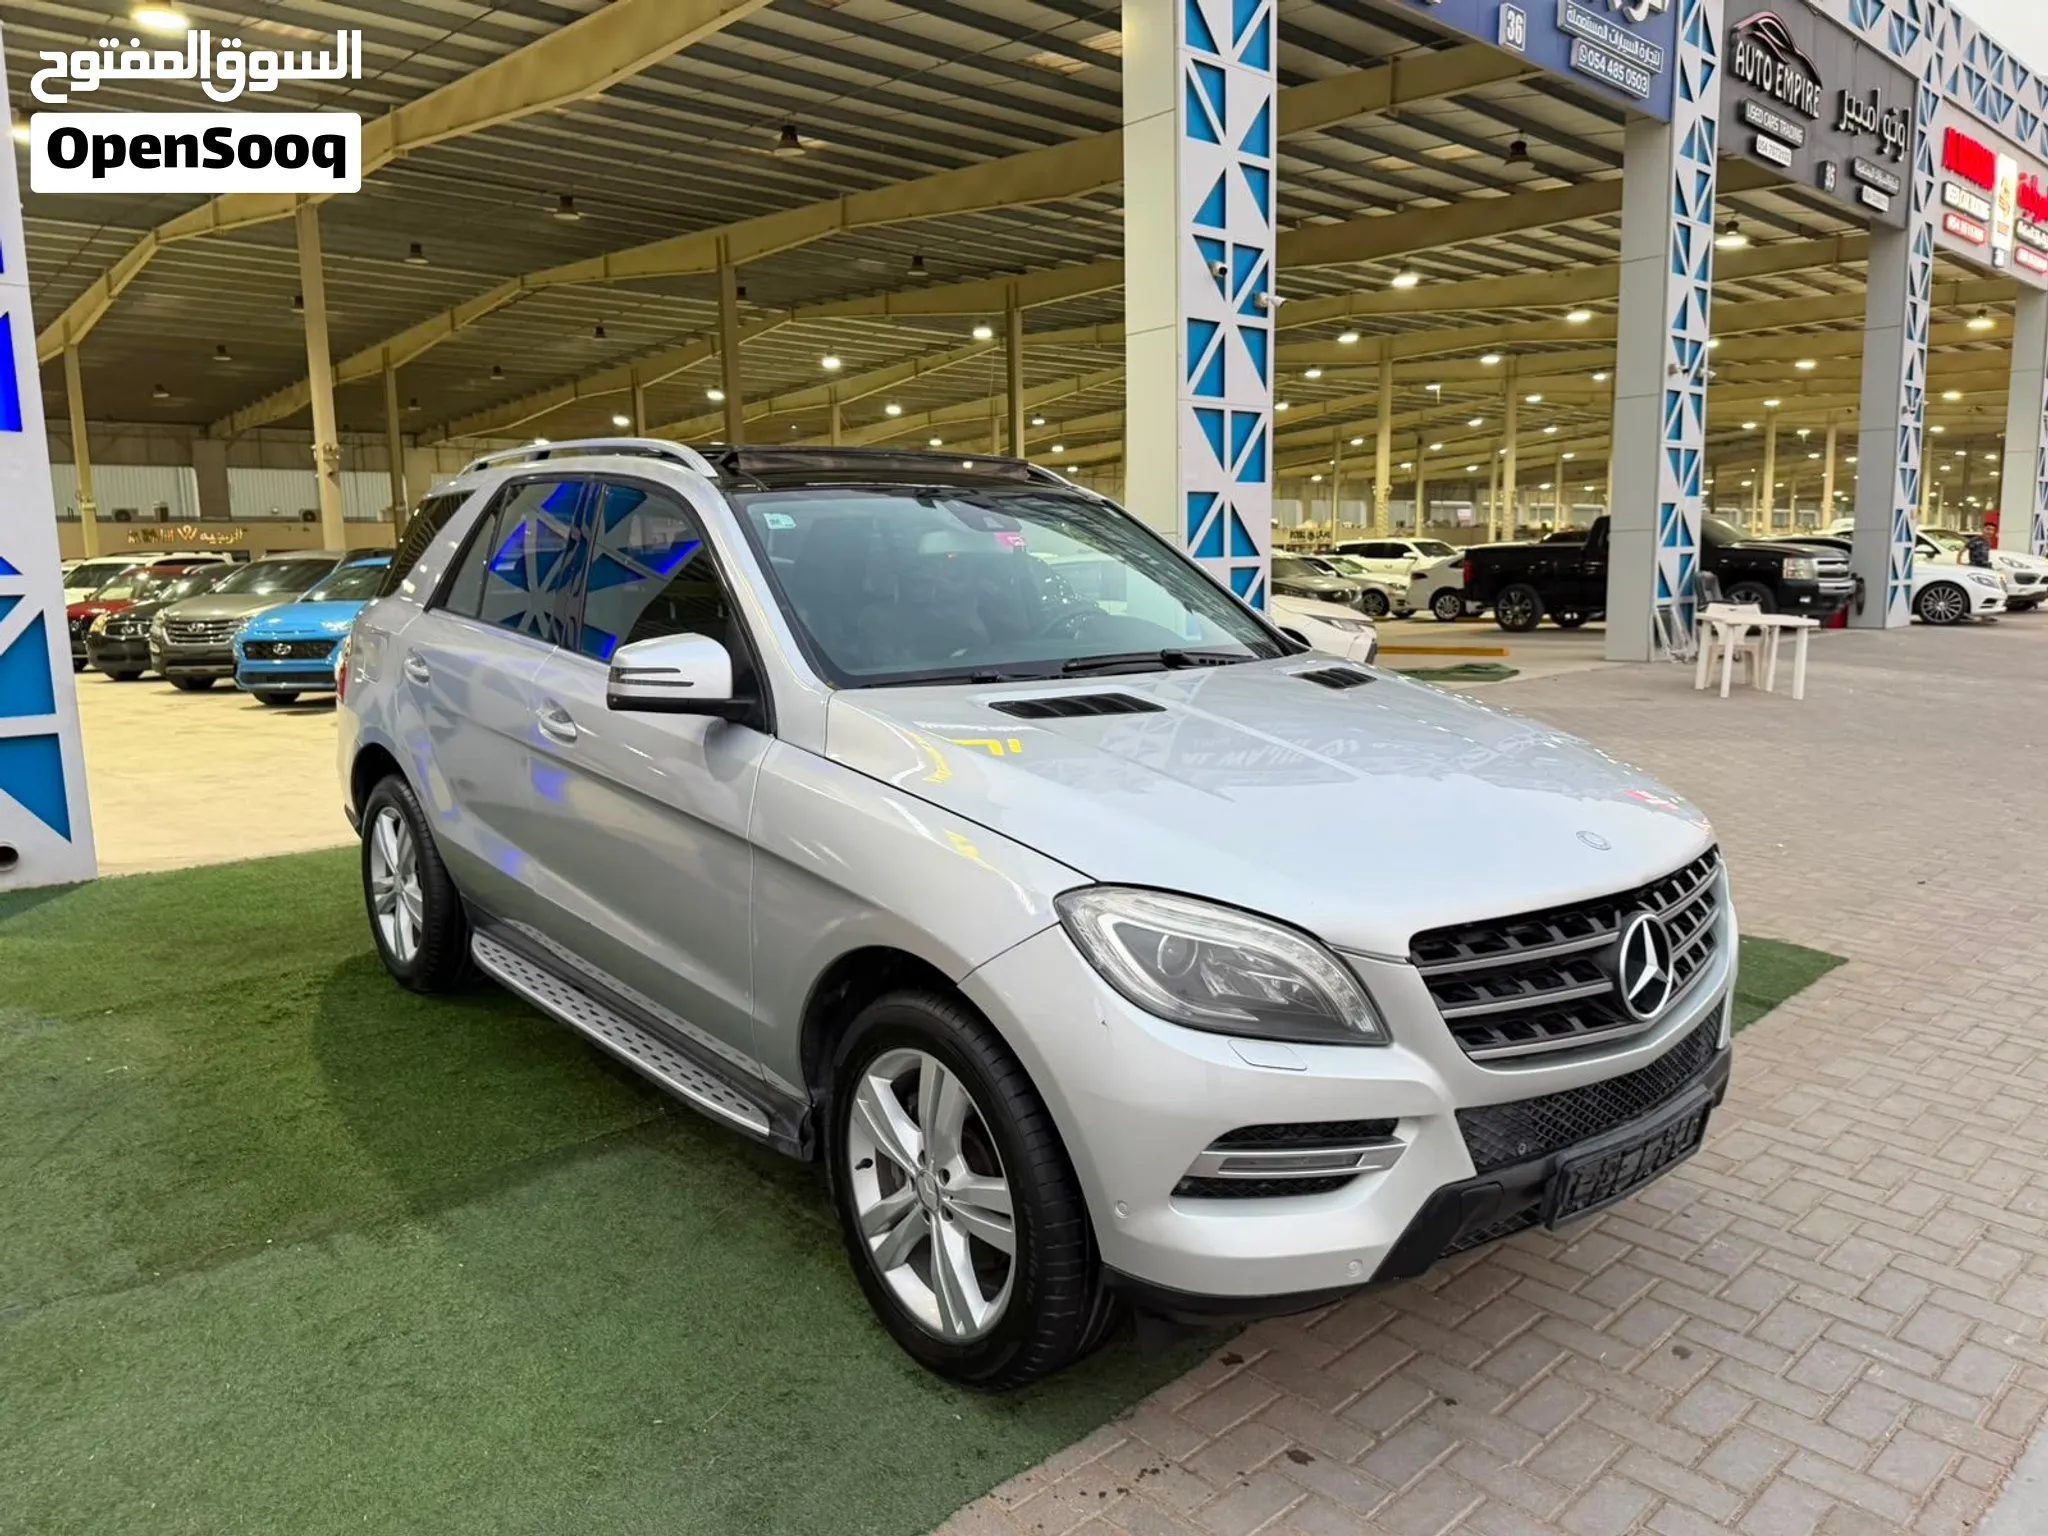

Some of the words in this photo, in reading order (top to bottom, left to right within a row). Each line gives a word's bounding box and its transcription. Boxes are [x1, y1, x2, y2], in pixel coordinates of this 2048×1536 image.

[1506, 11, 1523, 46] 36
[1588, 50, 1606, 73] 054
[1625, 68, 1648, 92] 0503
[1735, 40, 1773, 91] AUTO
[1775, 62, 1822, 118] EMPIRE
[1747, 102, 1763, 124] USED
[1763, 111, 1780, 132] CARS
[1839, 87, 1881, 135] امبير
[1882, 107, 1911, 162] اوتو
